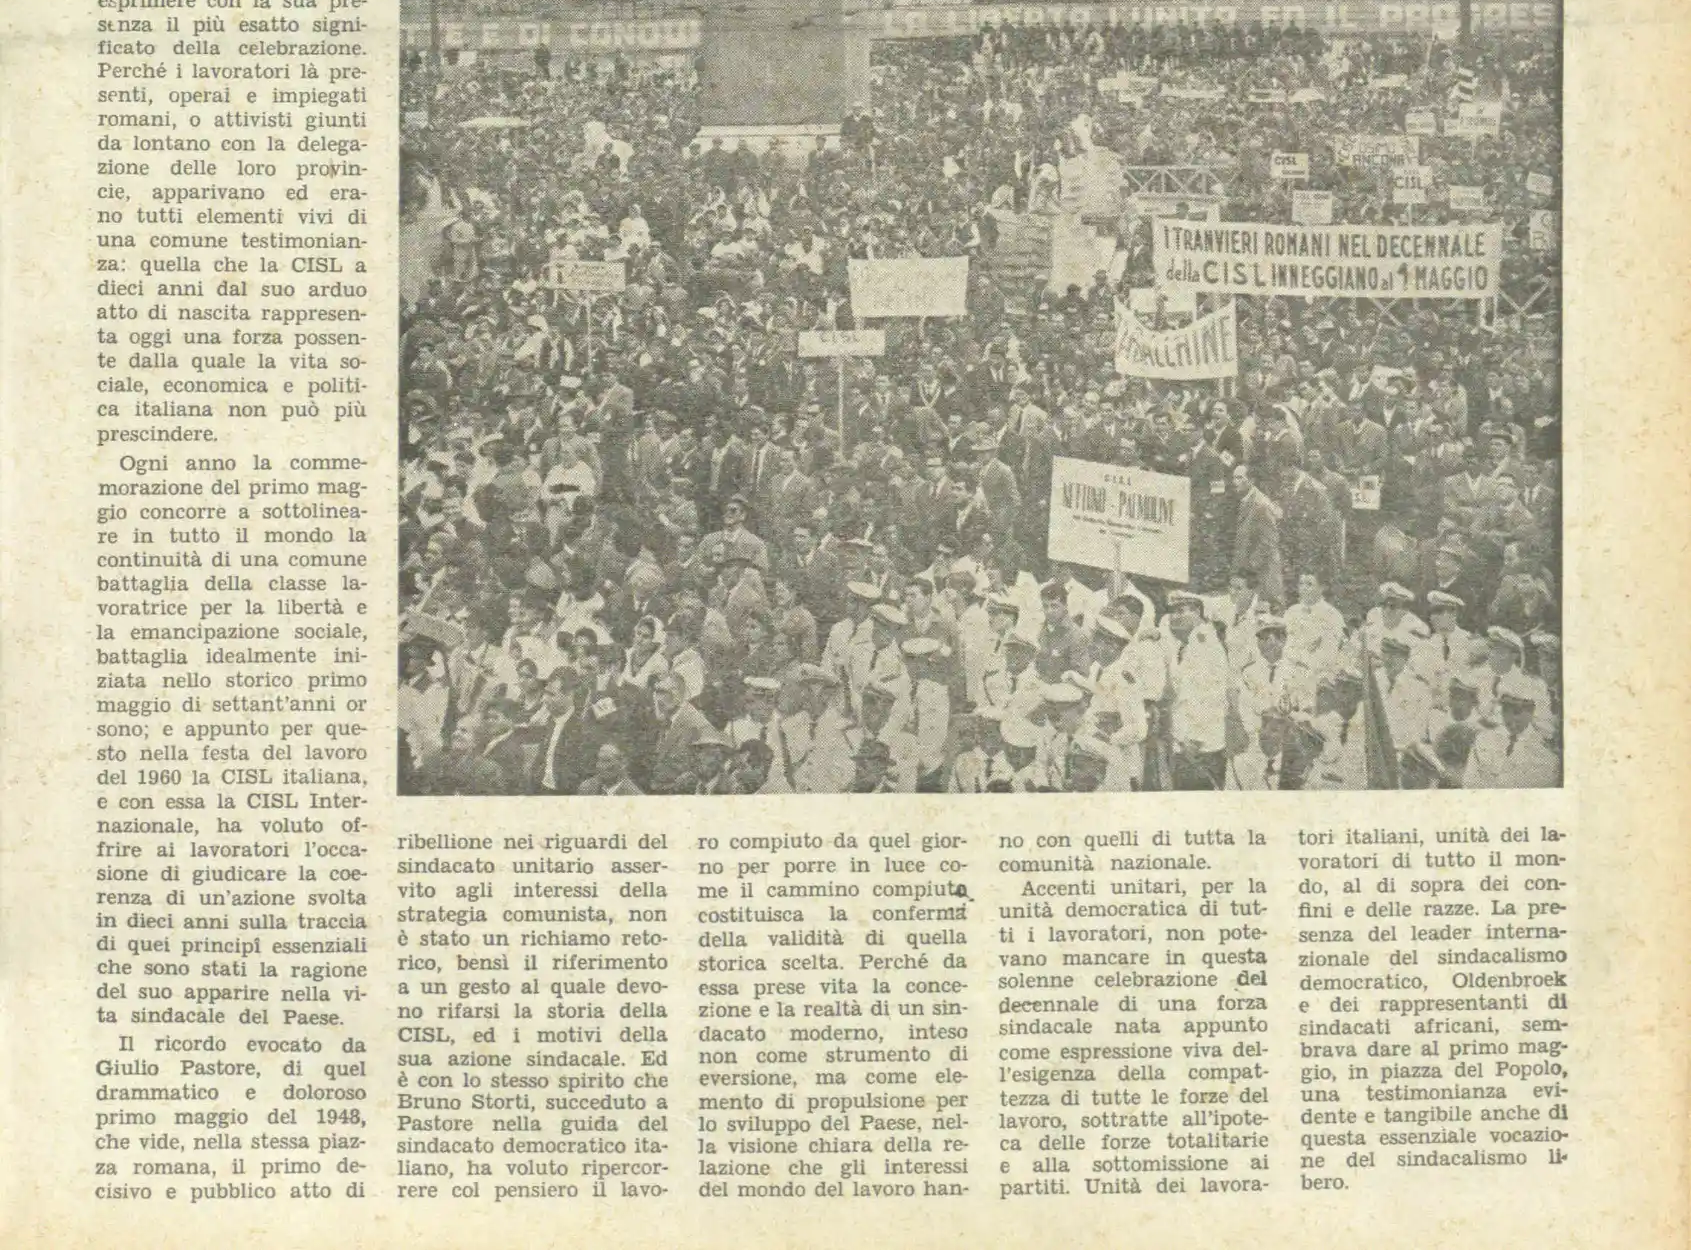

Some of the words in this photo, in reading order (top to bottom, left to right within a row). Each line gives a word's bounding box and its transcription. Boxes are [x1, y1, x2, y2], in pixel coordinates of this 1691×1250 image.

[1171, 226, 1258, 255] TRANVIERI
[1264, 231, 1331, 257] ROMANI
[1338, 232, 1371, 258] NEL
[1376, 231, 1486, 258] DECENNALE
[1165, 258, 1201, 283] della
[1202, 260, 1267, 287] CISL
[1271, 262, 1378, 289] INNEGGIANO
[1414, 264, 1489, 291] MAGGIO
[119, 454, 169, 475] Ogni
[185, 458, 237, 471] anno
[253, 454, 273, 471] la
[289, 457, 368, 471] comme-
[96, 769, 127, 786] del
[138, 769, 182, 786] 1960
[192, 769, 211, 786] la
[221, 768, 273, 785] CISL
[282, 767, 368, 786] italiana,
[1299, 973, 1428, 992] democratico,
[1451, 970, 1568, 989] Oldenbroek
[1300, 1064, 1337, 1084] gio,
[1348, 1064, 1369, 1081] in
[1380, 1062, 1443, 1084] piazza
[1454, 1061, 1484, 1078] del
[1495, 1059, 1569, 1081] Popolo,
[397, 1093, 462, 1111] Bruno
[471, 1093, 536, 1113] Storti,
[545, 1093, 647, 1111] succeduto
[656, 1097, 669, 1110] a
[95, 1109, 157, 1130] primo
[174, 1108, 249, 1129] maggio
[266, 1107, 298, 1125] del
[316, 1107, 367, 1129] 1948,
[698, 1115, 717, 1133] lo
[726, 1115, 811, 1136] sviluppo
[820, 1114, 850, 1132] del
[860, 1114, 922, 1133] Paese,
[931, 1113, 969, 1130] nel-
[999, 1178, 1070, 1199] partiti.
[1084, 1177, 1142, 1195] Unità
[1155, 1177, 1187, 1194] dei
[1200, 1176, 1270, 1194] lavora-
